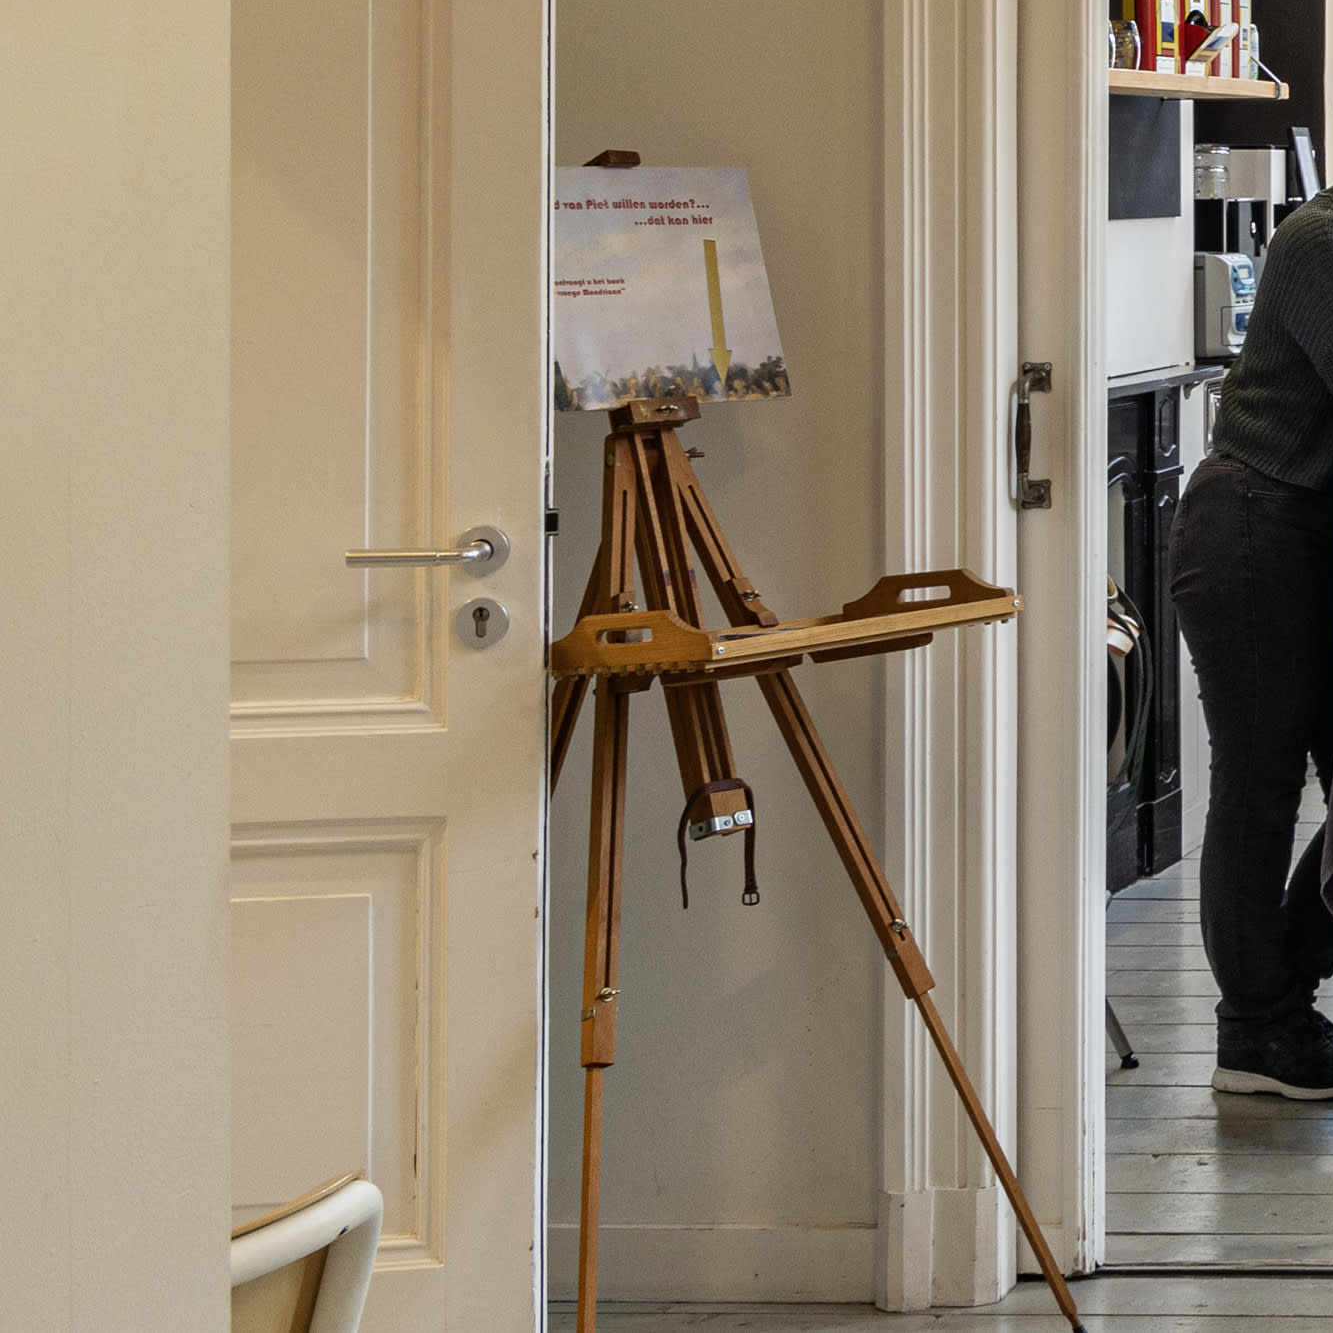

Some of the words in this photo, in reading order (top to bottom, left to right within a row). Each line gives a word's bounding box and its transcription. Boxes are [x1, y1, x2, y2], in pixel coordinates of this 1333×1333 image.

[562, 201, 583, 210] van
[586, 198, 609, 210] Piet
[612, 198, 646, 209] willen
[667, 215, 689, 225] kan
[691, 214, 713, 225] hier
